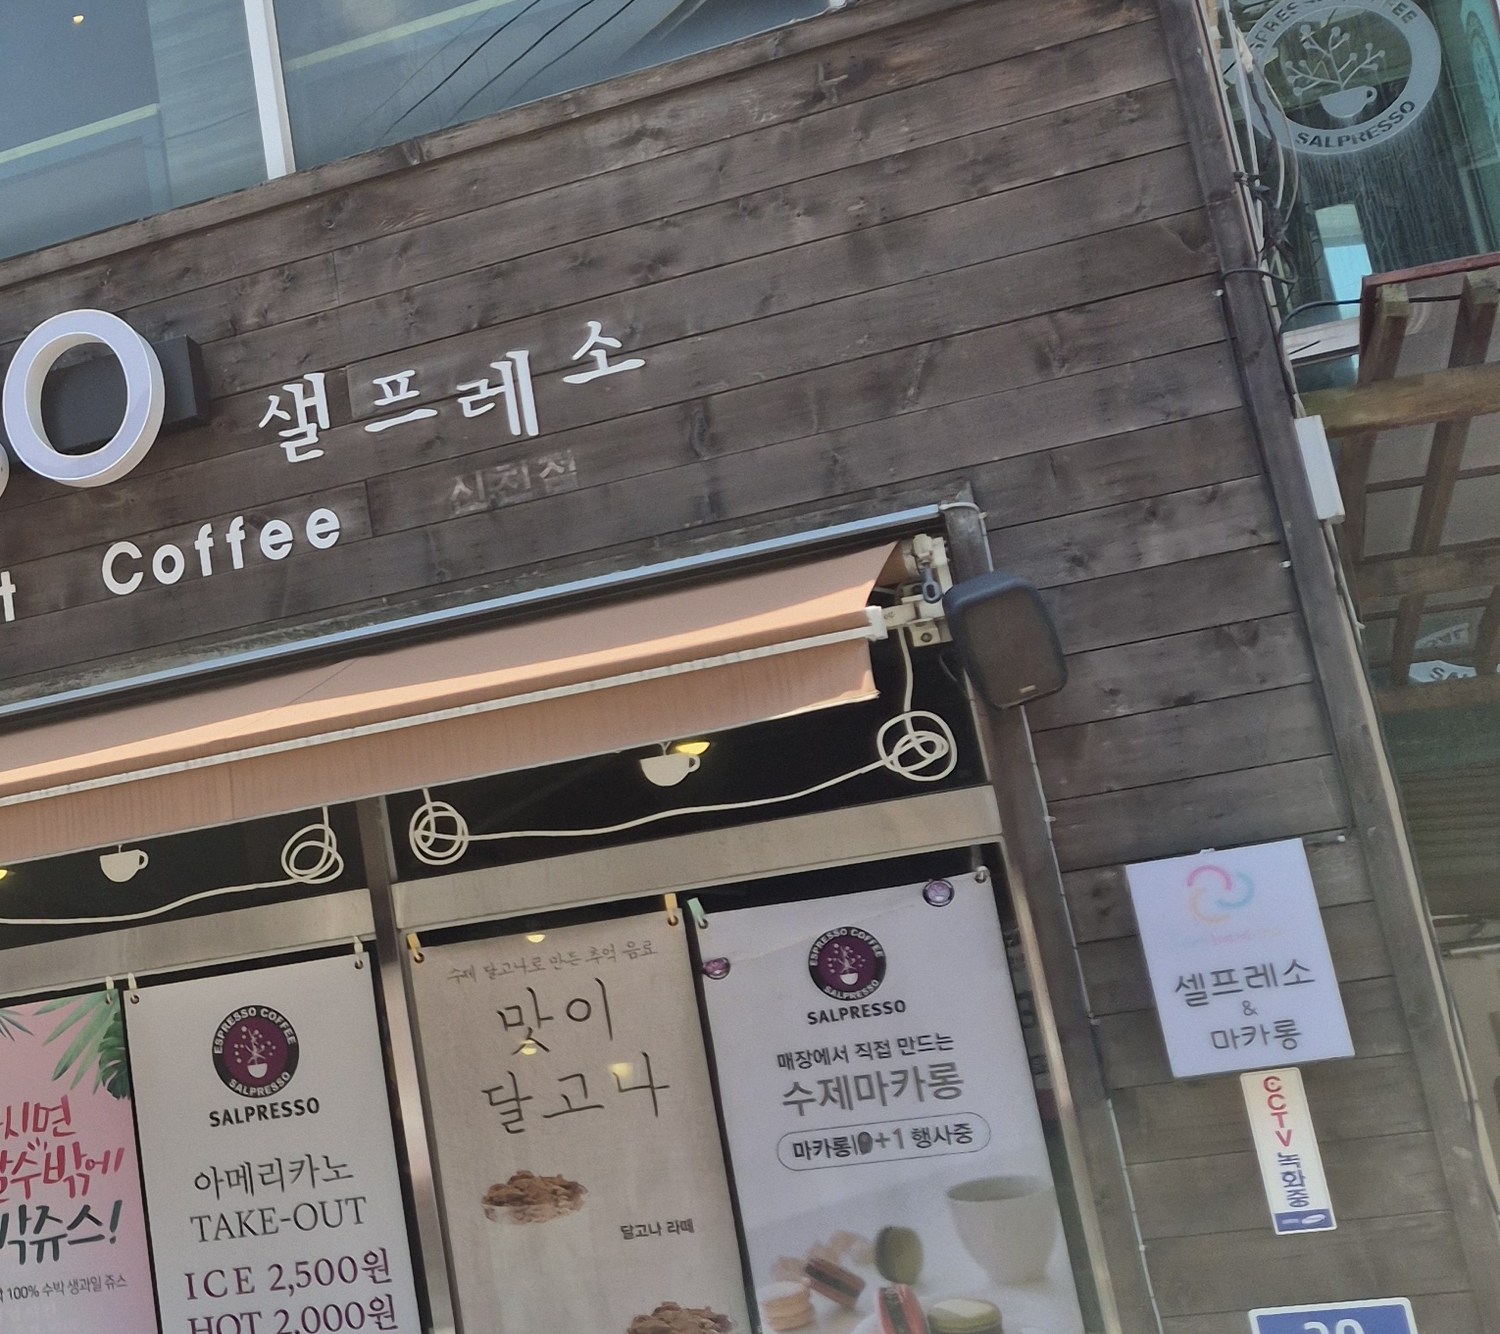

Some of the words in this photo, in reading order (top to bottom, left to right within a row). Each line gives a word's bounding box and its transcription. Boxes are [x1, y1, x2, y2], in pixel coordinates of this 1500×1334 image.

[1295, 100, 1416, 148] SALPRESSO
[258, 320, 646, 463] 샐프레소
[102, 505, 342, 597] Coffee
[810, 928, 848, 966] ESPRESSO
[850, 929, 884, 958] COFFEE
[824, 979, 880, 1001] SALPRESSO
[1175, 959, 1316, 1007] 셀프레소
[807, 999, 906, 1025] SALPRESSO
[1242, 1000, 1258, 1016] &
[213, 1007, 257, 1055] ESPRESSO
[260, 1007, 297, 1045] COFFEE
[777, 1045, 849, 1071] 매장에서
[854, 1039, 893, 1062] 직접
[897, 1032, 955, 1056] 만드는
[1210, 1019, 1302, 1050] 마카롱
[228, 1070, 291, 1097] SALPRESSO
[481, 1051, 670, 1134] 달고나
[782, 1062, 964, 1117] 수제마카롱
[208, 1097, 320, 1128] SALPRESSO
[1263, 1076, 1292, 1147] CCTV
[911, 1123, 974, 1149] 행사중
[194, 1154, 354, 1201] 아메리카노
[190, 1196, 367, 1243] TAKE-OUT
[620, 1221, 662, 1240] 달고나
[7, 1283, 40, 1300] 100%
[42, 1280, 66, 1297] 수박
[185, 1266, 255, 1300] ICE
[269, 1247, 392, 1297] 2,500원
